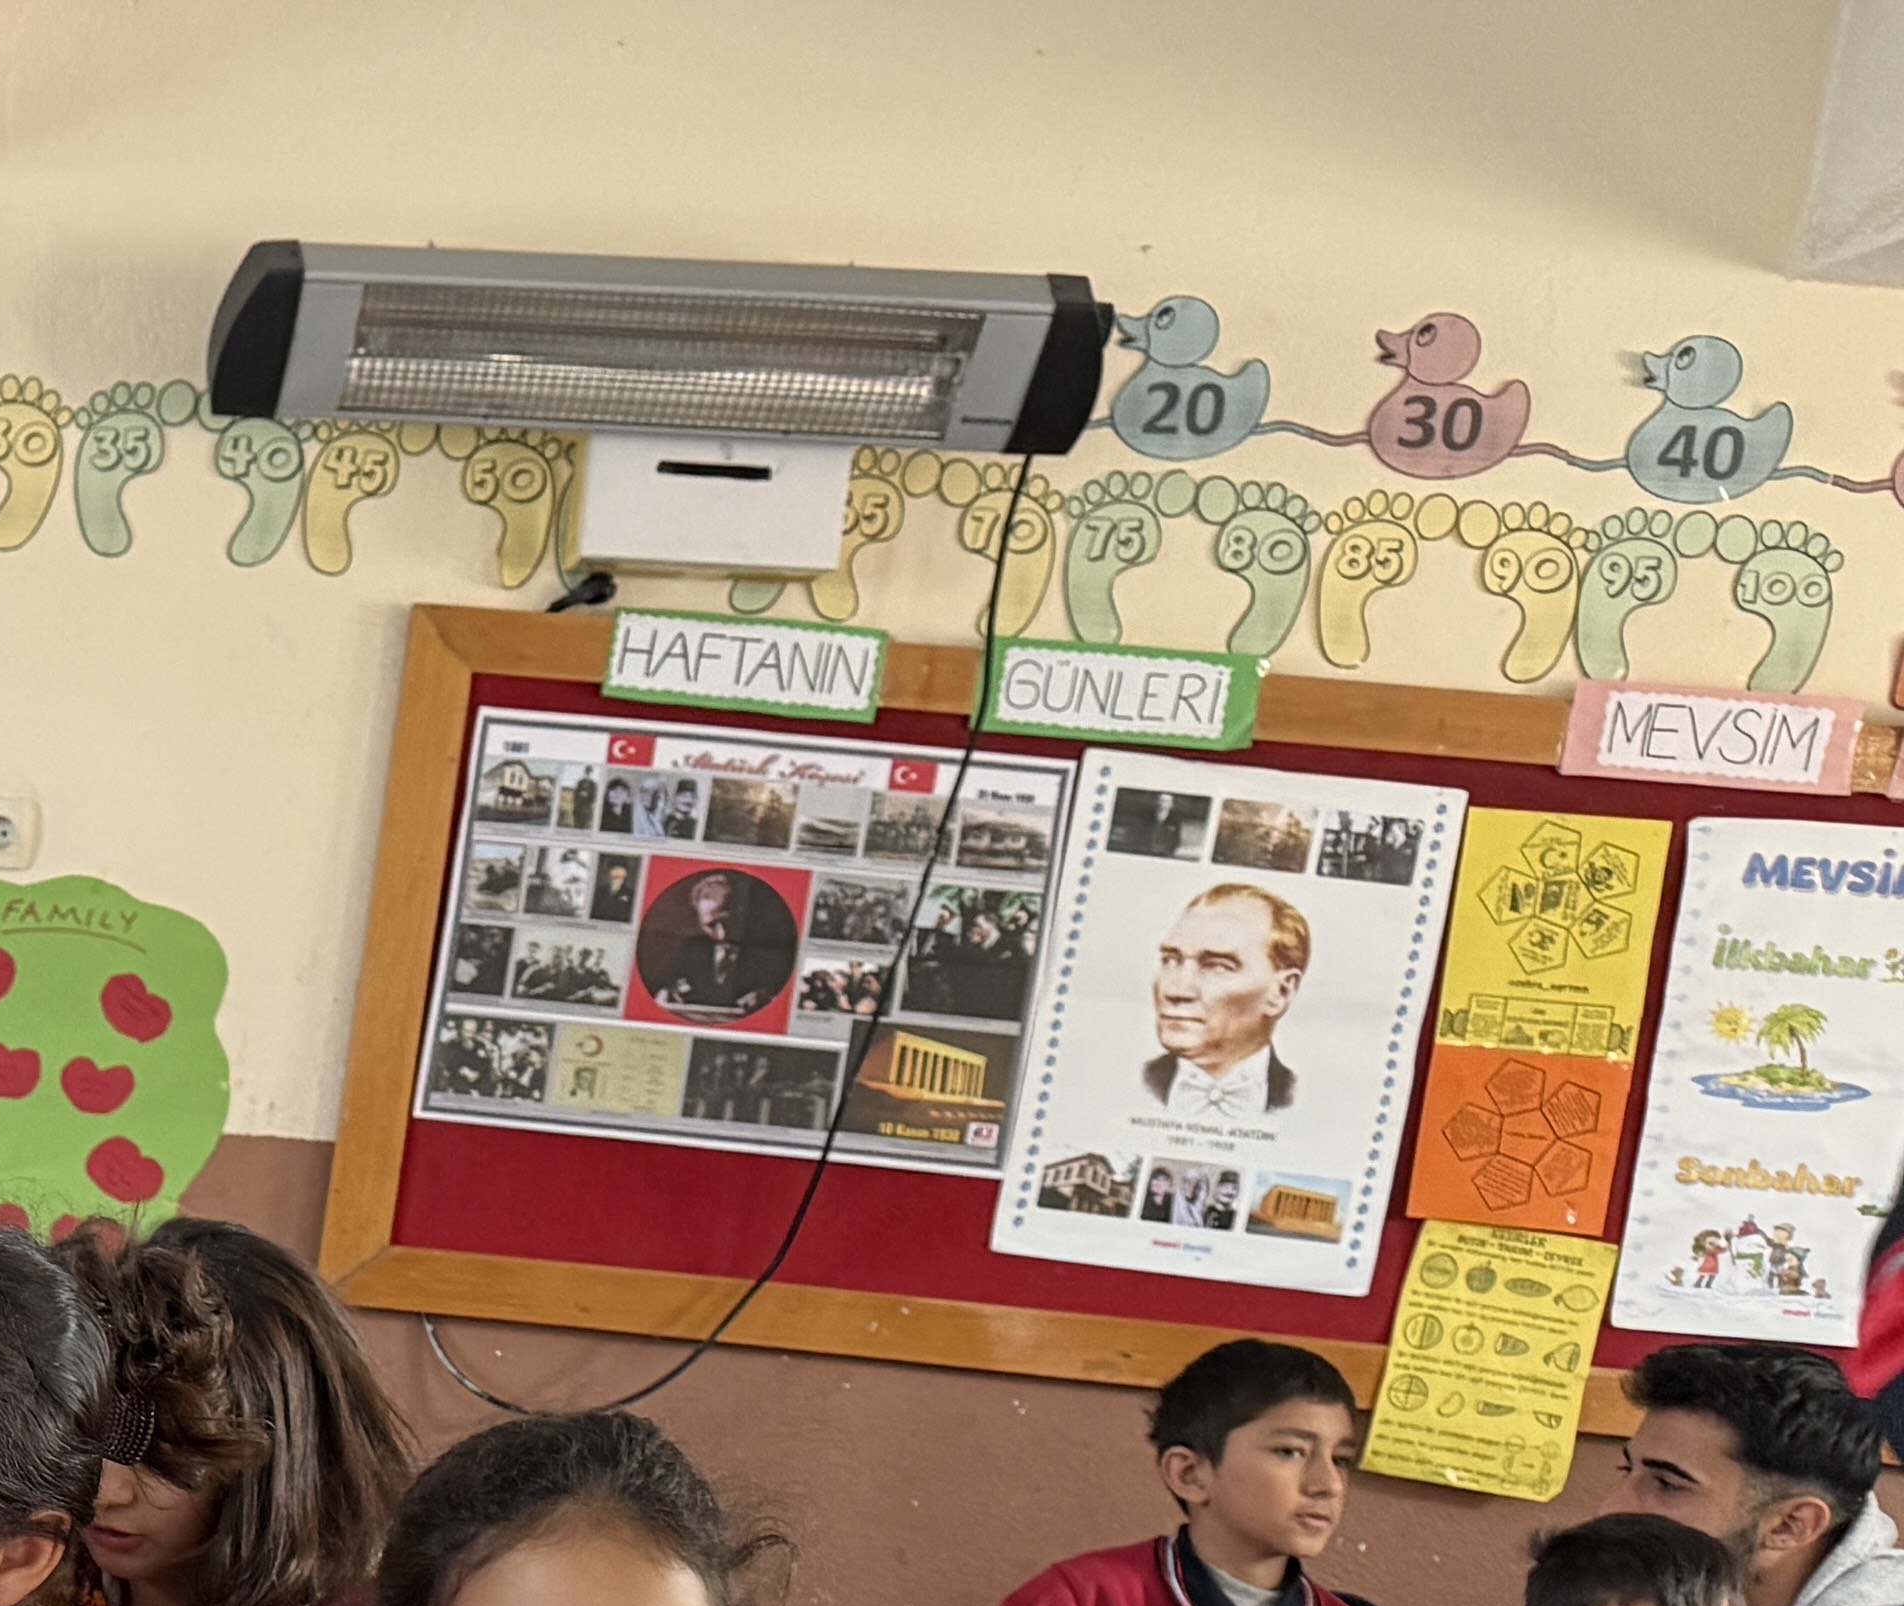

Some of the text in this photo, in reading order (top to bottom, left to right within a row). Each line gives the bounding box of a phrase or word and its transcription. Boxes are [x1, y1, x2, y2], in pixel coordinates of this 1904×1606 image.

[1143, 380, 1227, 437] 20
[1398, 394, 1484, 452] 30
[88, 423, 152, 471] 35
[219, 438, 300, 484] 40
[1657, 423, 1745, 480] 40
[324, 450, 389, 495] 45
[473, 458, 546, 504] 50
[1085, 517, 1149, 564] 75
[1222, 526, 1297, 572] 80
[1339, 536, 1403, 583] 85
[1490, 545, 1573, 593] 90
[1600, 554, 1663, 602] 95
[1739, 567, 1830, 609] 100
[617, 626, 871, 697] HAFTANIN
[1004, 655, 1226, 726] GÜNLERİ
[1607, 700, 1820, 772] MEVSİM
[1, 899, 139, 934] FAMILY
[1675, 1155, 1863, 1198] Sonbahar
